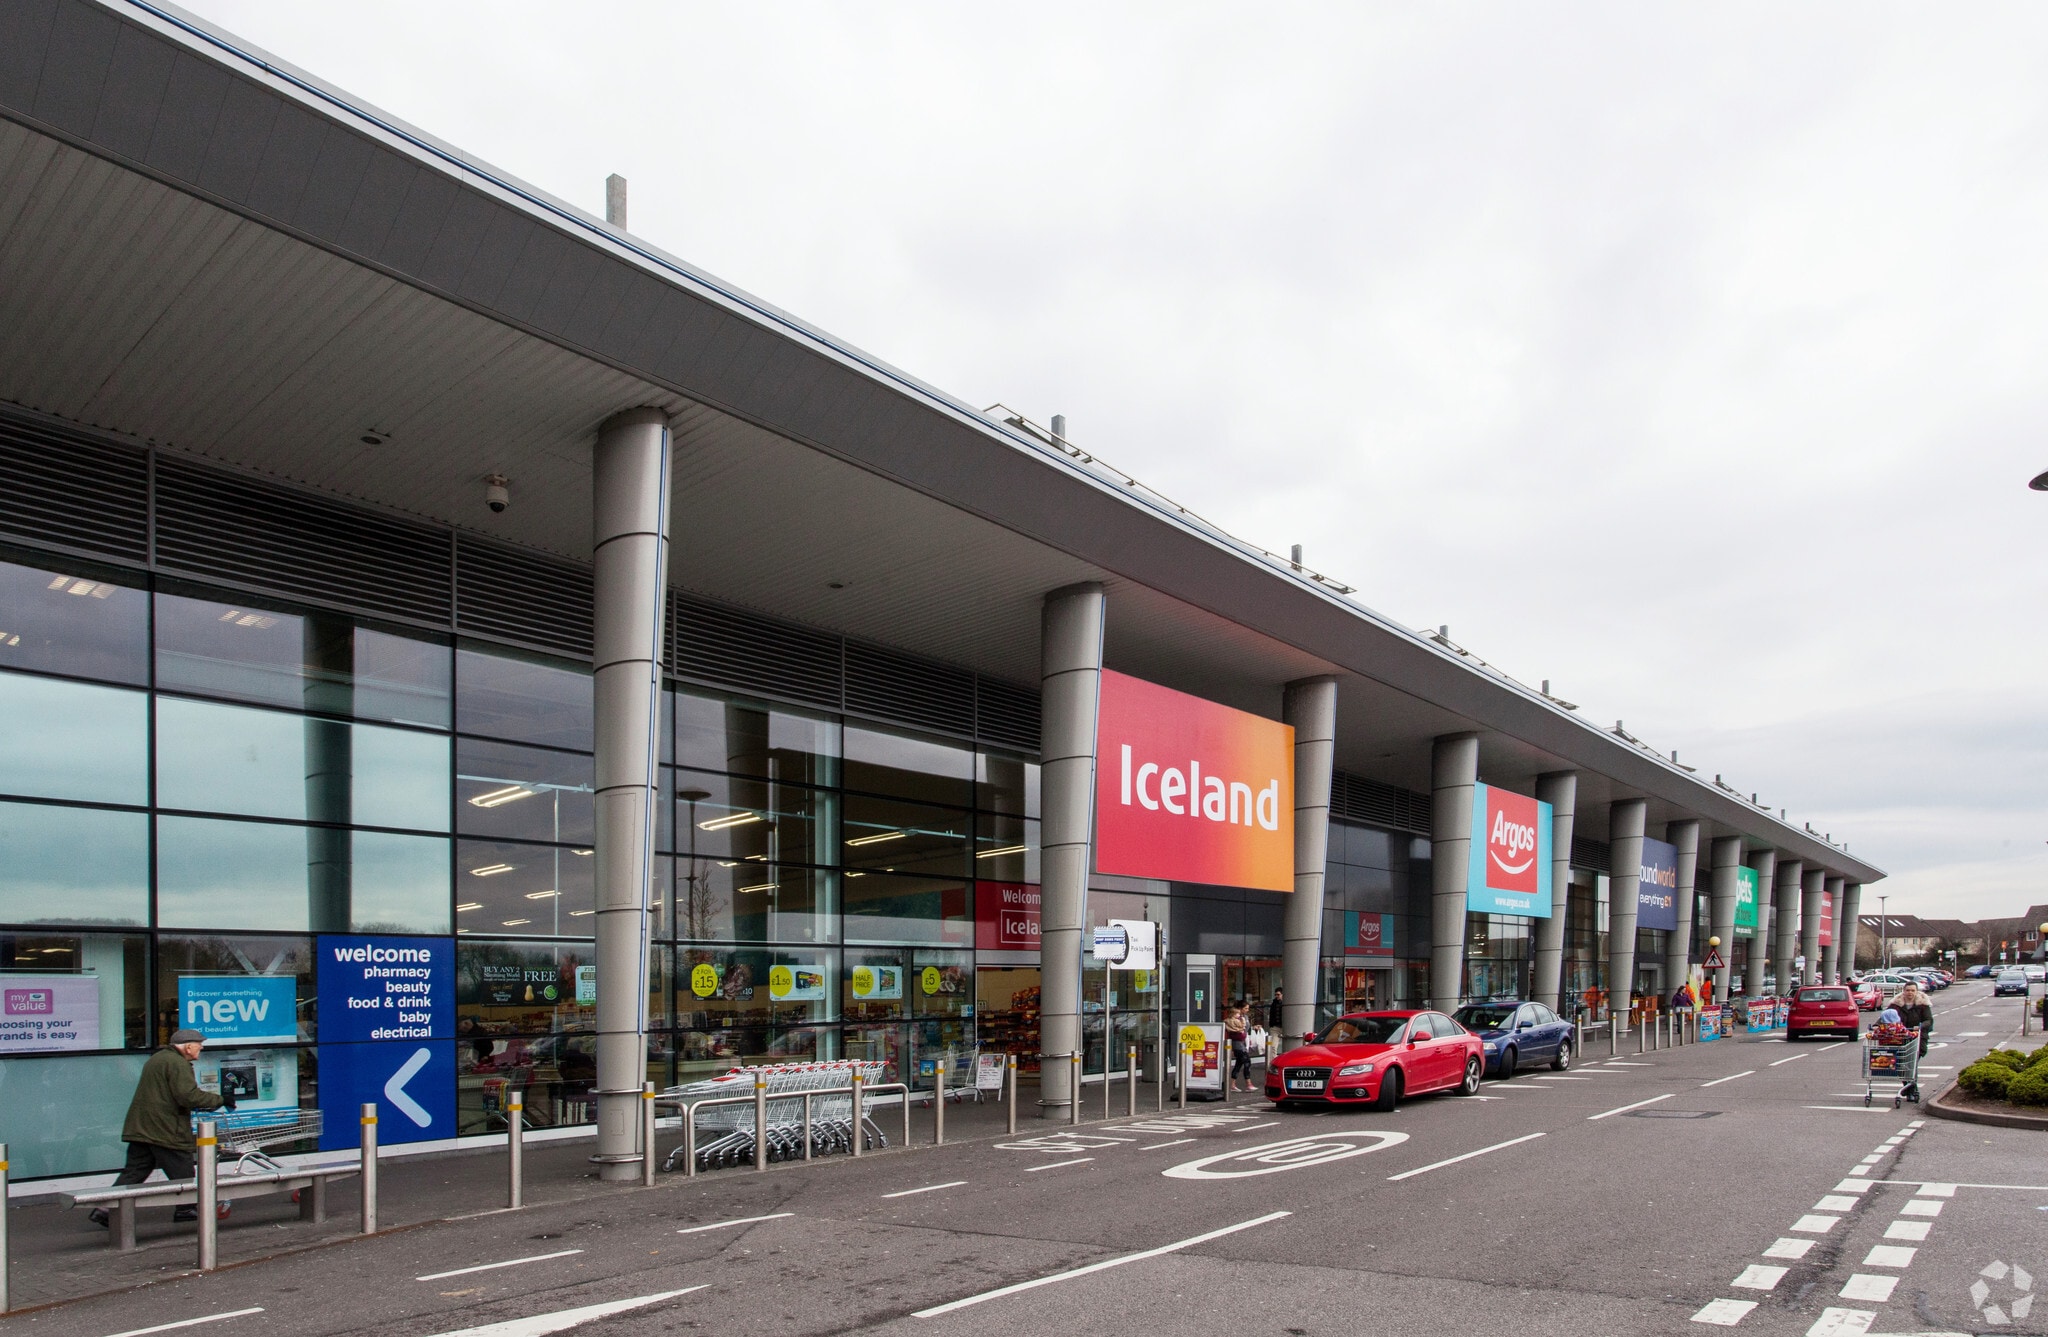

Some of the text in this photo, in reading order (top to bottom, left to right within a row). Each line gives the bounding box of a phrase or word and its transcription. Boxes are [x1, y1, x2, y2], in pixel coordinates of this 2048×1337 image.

[1121, 744, 1278, 831] Iceland
[1491, 810, 1534, 858] Argos
[1640, 863, 1676, 888] oundworld
[1002, 889, 1041, 905] Welcom
[1736, 874, 1752, 906] pets
[1640, 893, 1672, 909] everything £1
[1005, 918, 1041, 935] Icela
[1360, 919, 1380, 936] Argos
[334, 944, 431, 963] welcome
[364, 966, 431, 979] pharmacy
[524, 970, 557, 982] FREE
[925, 973, 935, 986] £5
[694, 976, 714, 989] £15
[771, 974, 791, 986] £1.50
[386, 981, 431, 994] beauty
[11, 994, 26, 1002] my
[348, 995, 431, 1009] food & drink
[11, 1001, 47, 1011] value
[187, 999, 270, 1024] new
[46, 1020, 73, 1029] your
[399, 1011, 431, 1024] baby
[0, 1031, 78, 1041] rands is easy
[205, 1025, 238, 1033] beautiful
[371, 1025, 432, 1039] electrical
[1181, 1033, 1203, 1041] ONLY
[993, 1113, 1260, 1153] SET DOWN
[1235, 1142, 1357, 1163] 10
